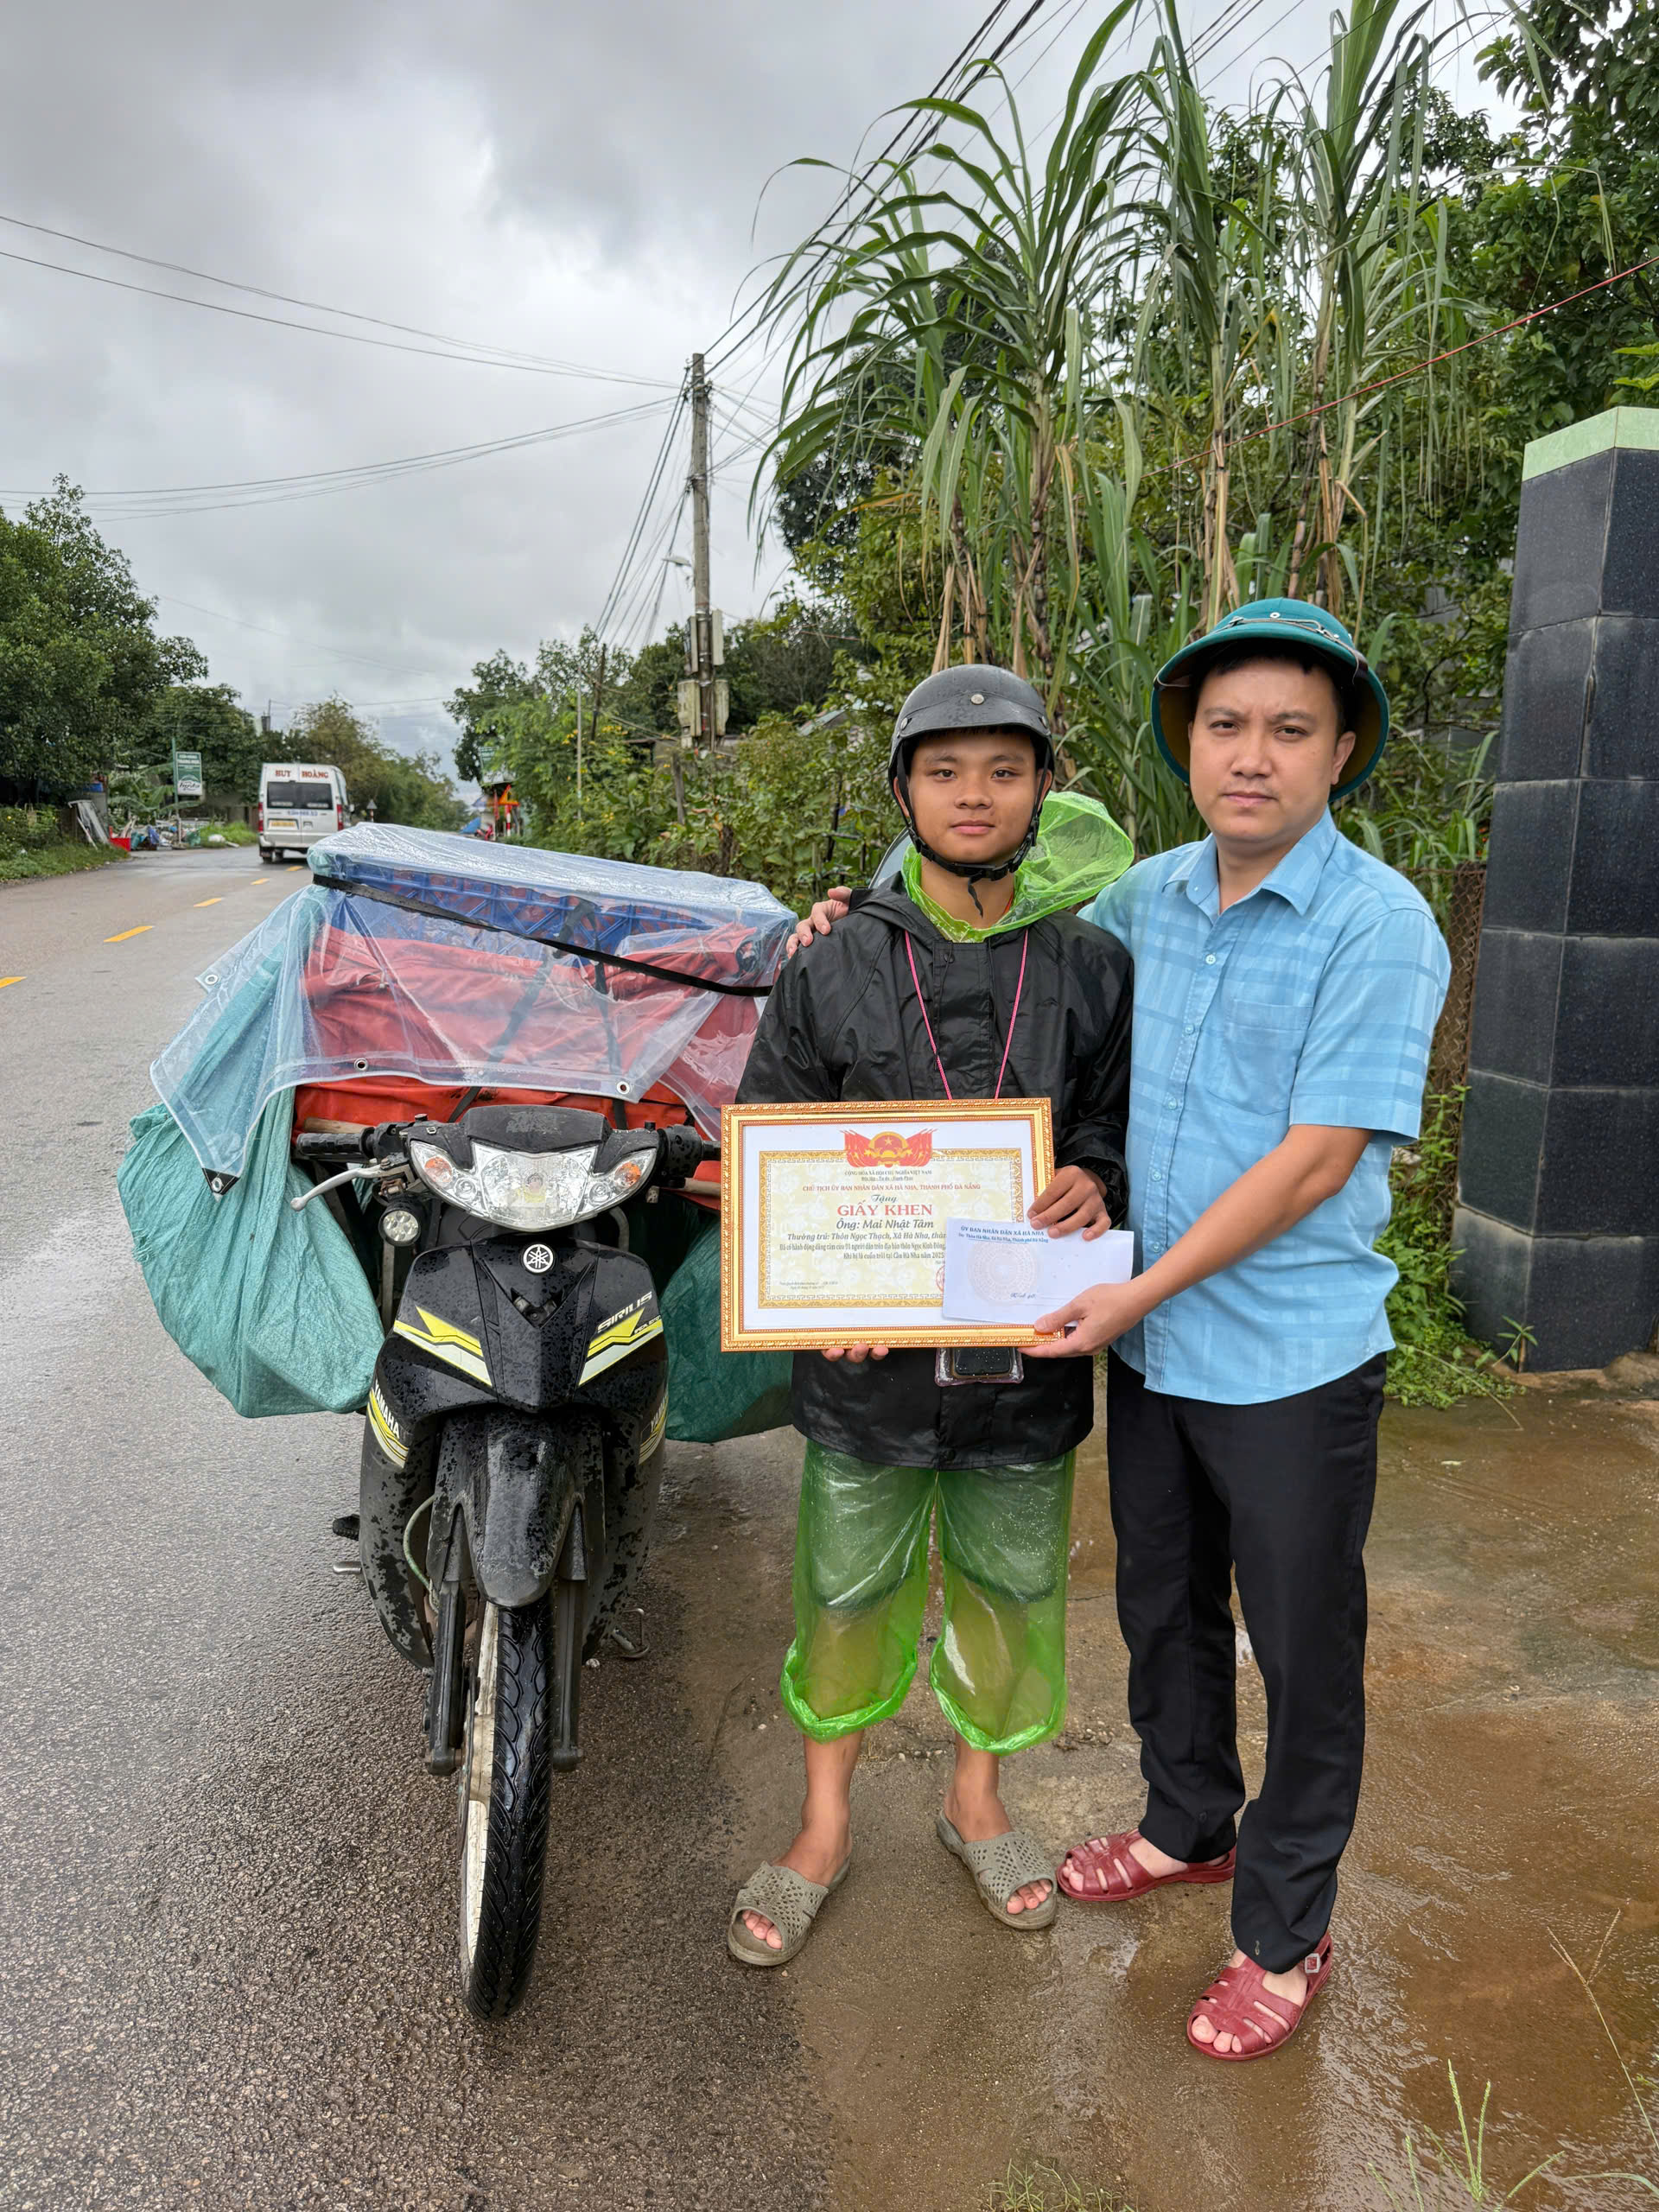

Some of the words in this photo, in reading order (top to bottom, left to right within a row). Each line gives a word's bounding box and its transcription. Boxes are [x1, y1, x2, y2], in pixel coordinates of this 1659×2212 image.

[837, 1199, 879, 1216] GIẤY
[885, 1205, 932, 1216] KHEN
[836, 1217, 861, 1230] Ông:
[862, 1219, 882, 1229] Mai
[885, 1219, 911, 1230] Nhật
[912, 1219, 934, 1229] Tâm
[788, 1233, 816, 1242] Thường
[850, 1233, 868, 1242] Ngọc
[869, 1232, 892, 1241] Thạch,
[597, 1291, 652, 1333] SIRIUS
[374, 1377, 400, 1440] YAMAHA
